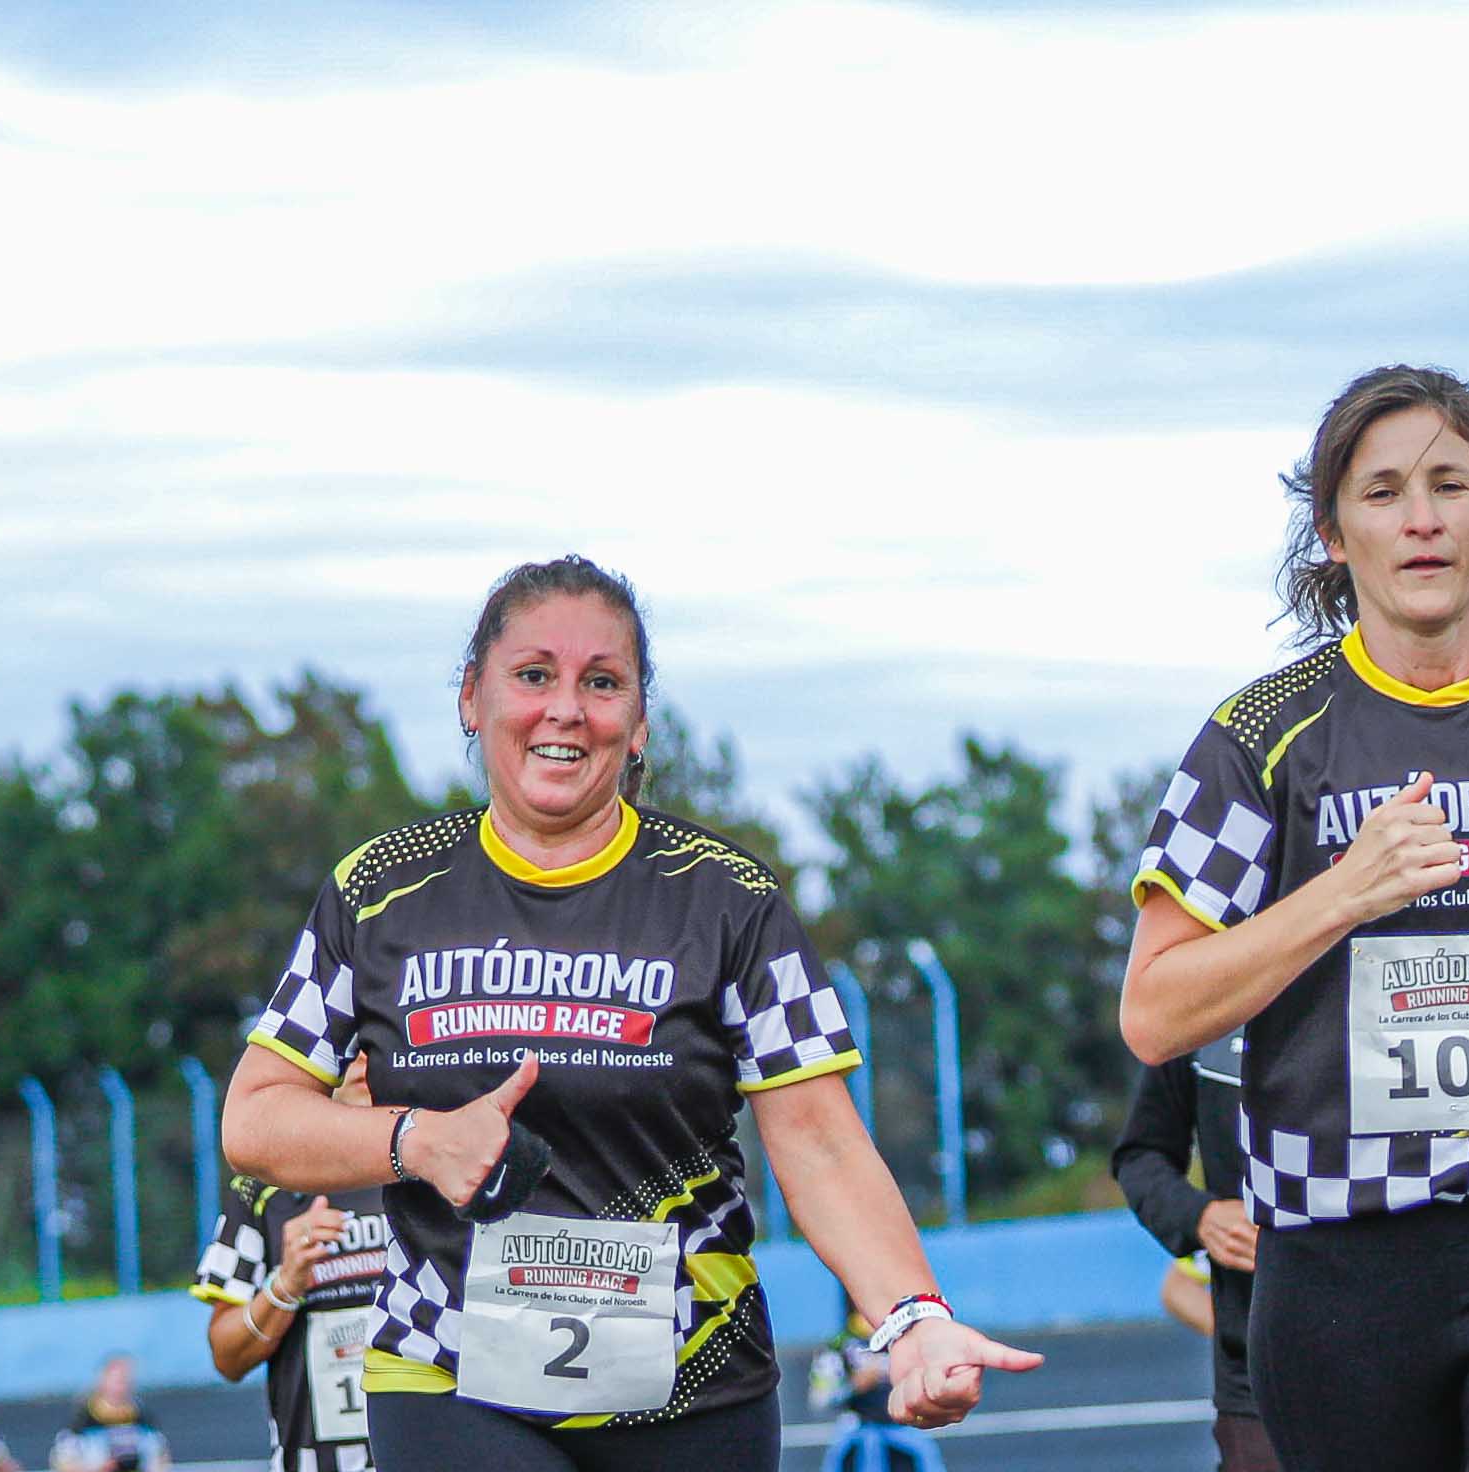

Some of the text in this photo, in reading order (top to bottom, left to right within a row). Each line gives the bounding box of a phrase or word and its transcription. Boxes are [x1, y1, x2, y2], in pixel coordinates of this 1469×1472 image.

[397, 938, 675, 1007] AUTÓDROMO
[1406, 988, 1468, 1009] RUNNING
[432, 1005, 625, 1040] RUNNING RACE
[1391, 1015, 1423, 1024] Carrera
[393, 1047, 674, 1068] La Carrera de los Clbes del Noroeste
[501, 1229, 653, 1274] AUTÓDROMO
[523, 1266, 628, 1291] RUNNING RACE
[507, 1287, 539, 1299] Carrera
[543, 1316, 591, 1380] 2
